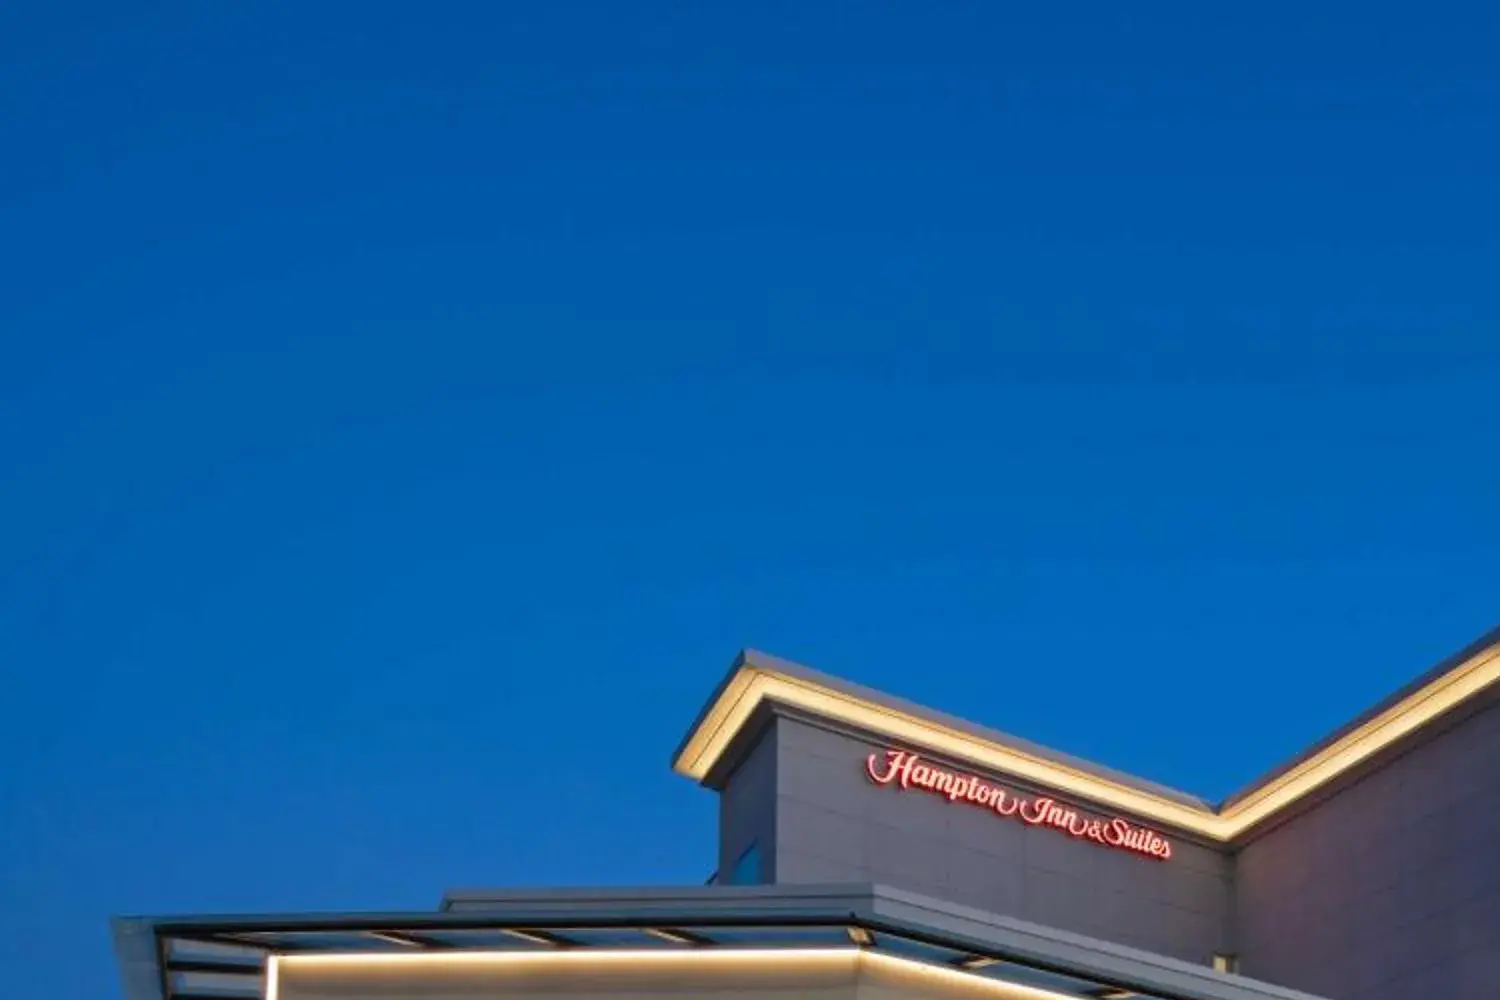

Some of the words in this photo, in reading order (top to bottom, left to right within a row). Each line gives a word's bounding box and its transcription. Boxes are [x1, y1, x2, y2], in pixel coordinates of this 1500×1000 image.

[867, 750, 1017, 815] Hampton
[1019, 797, 1088, 835] Inn
[1103, 817, 1172, 859] Suites
